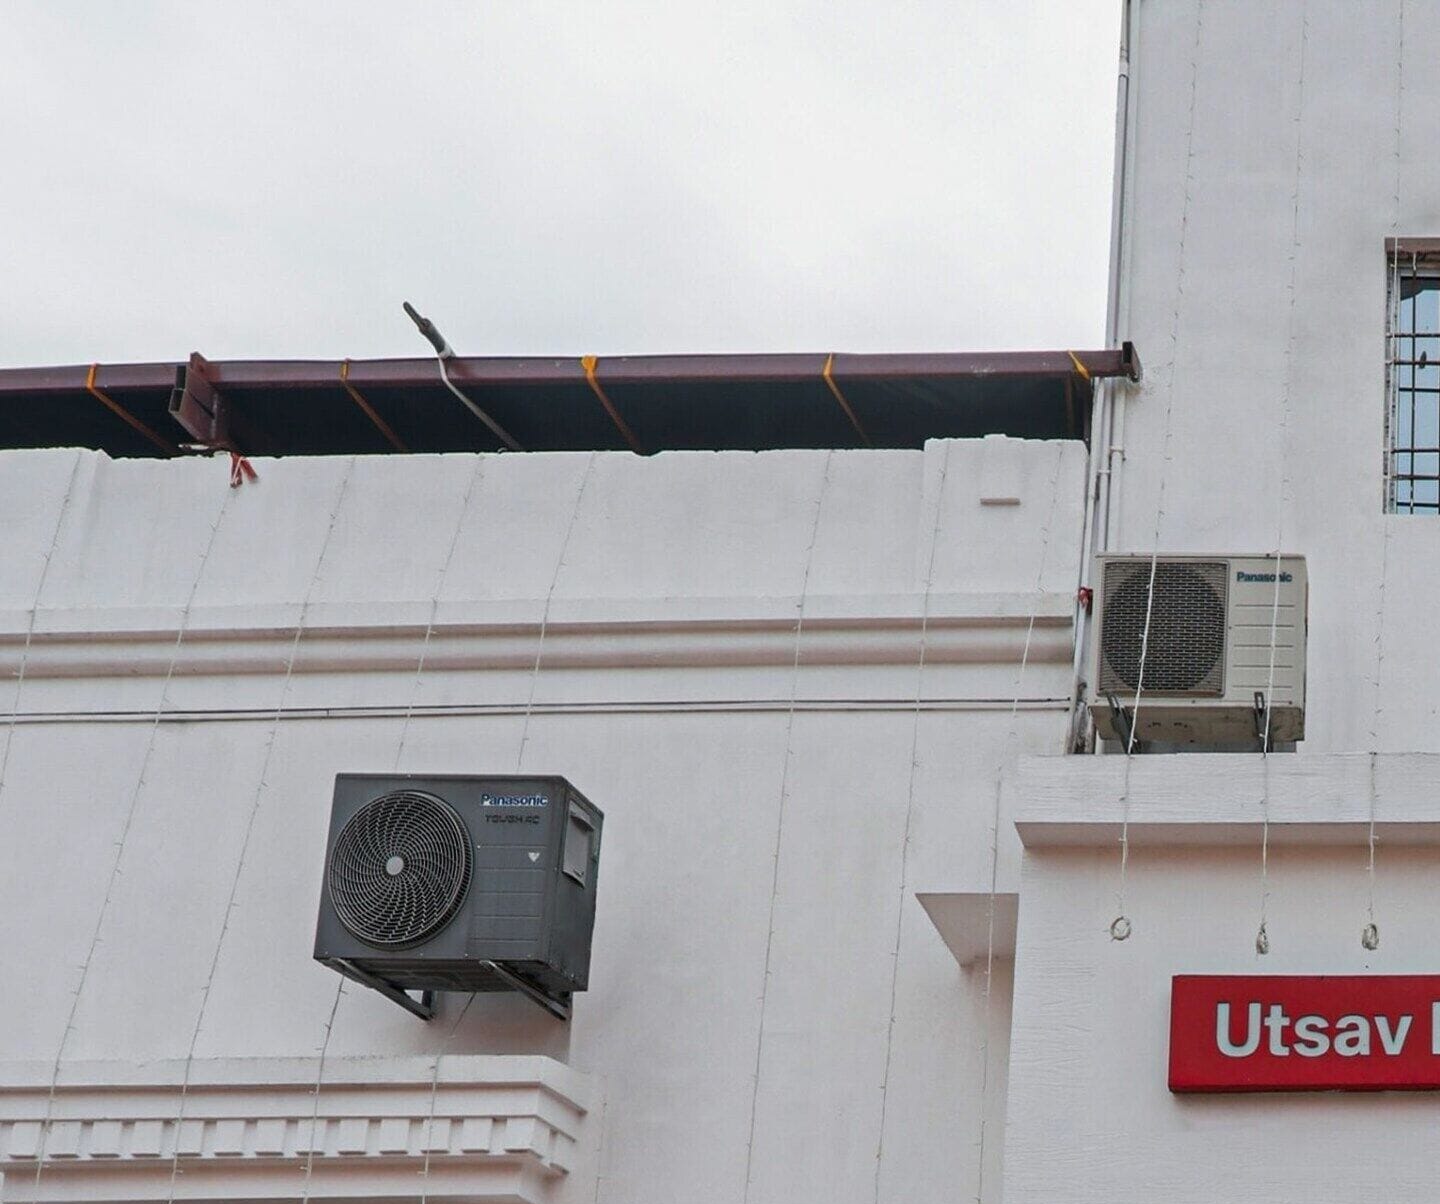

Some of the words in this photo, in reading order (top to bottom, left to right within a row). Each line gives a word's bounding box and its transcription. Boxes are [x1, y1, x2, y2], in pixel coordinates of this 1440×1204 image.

[1236, 571, 1293, 583] Panasonic
[480, 793, 548, 807] Panasonic
[1215, 1001, 1413, 1057] Utsav
